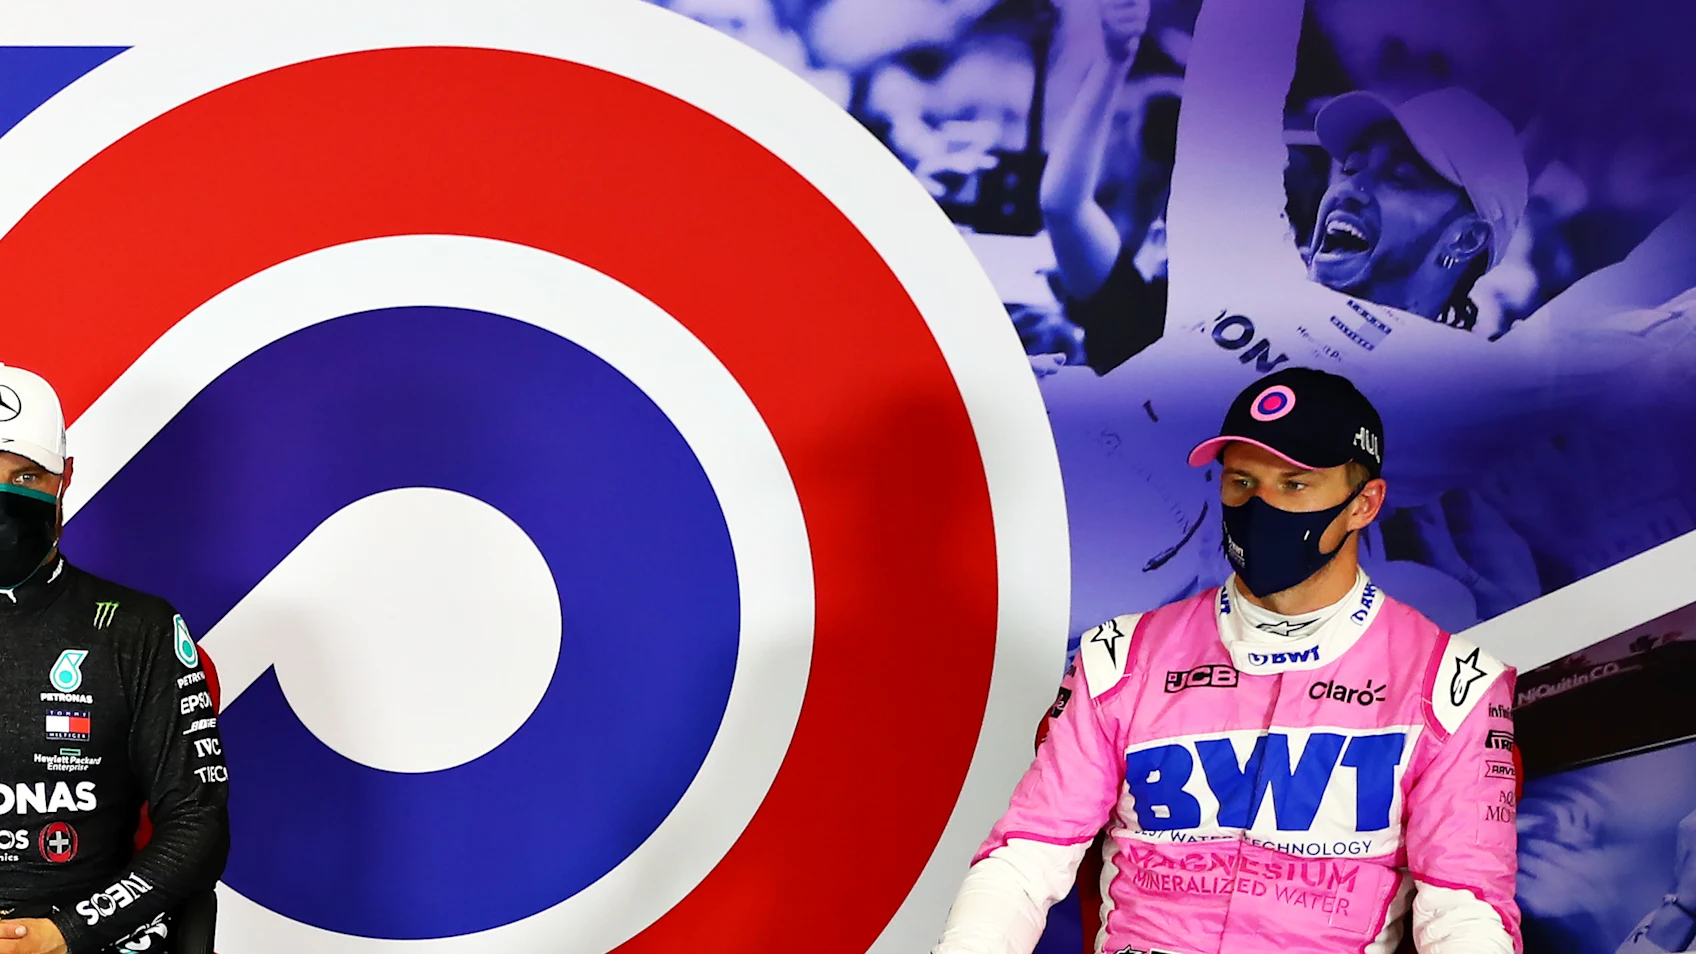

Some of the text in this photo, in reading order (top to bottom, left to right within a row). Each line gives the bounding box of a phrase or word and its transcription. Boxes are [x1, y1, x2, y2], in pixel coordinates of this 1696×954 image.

[1212, 310, 1290, 374] ON
[1271, 644, 1320, 664] BWT
[1166, 666, 1239, 692] JCB
[40, 692, 94, 704] PETRONAS
[1309, 680, 1376, 706] Claro
[33, 753, 69, 764] Hewlett
[1125, 732, 1407, 833] BWT
[76, 872, 153, 926] INEOS
[1275, 884, 1350, 916] WATER
